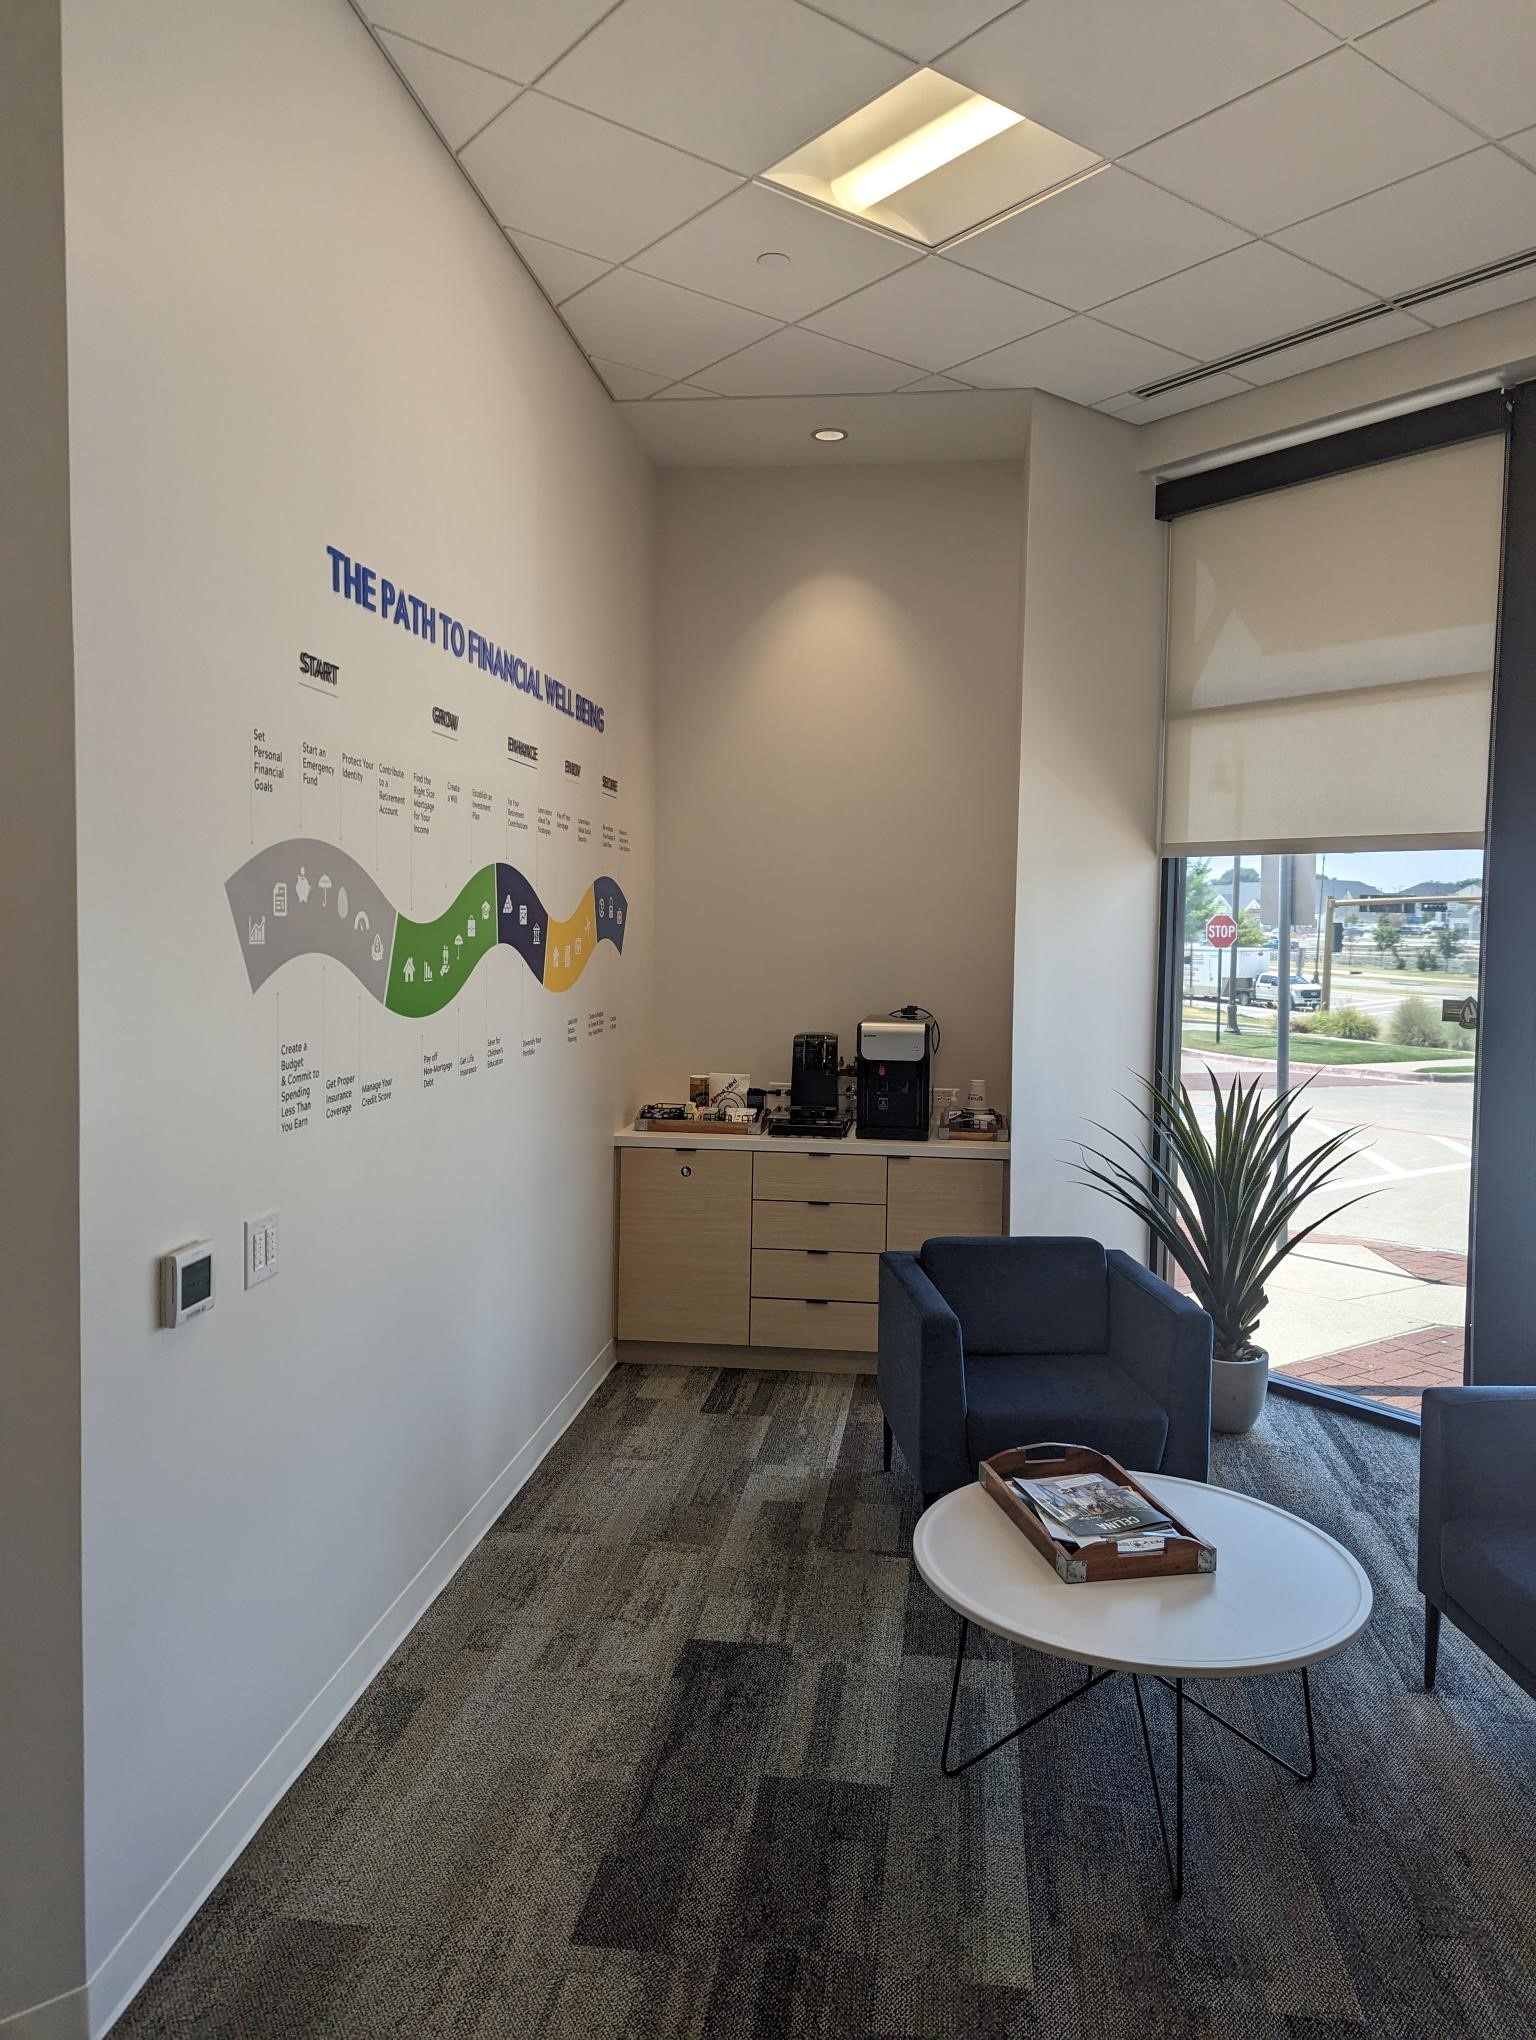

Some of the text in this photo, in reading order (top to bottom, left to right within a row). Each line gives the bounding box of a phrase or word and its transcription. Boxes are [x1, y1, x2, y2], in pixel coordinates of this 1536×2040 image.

[327, 545, 604, 732] THE PATH TO FINANCIAL WELL BEING
[300, 652, 339, 685] START
[432, 706, 459, 731] GROW
[253, 729, 265, 742] Set
[254, 745, 282, 762] Personal
[303, 742, 326, 758] Start an
[508, 737, 538, 760] ENHANCE
[303, 758, 334, 776] Emergency
[342, 753, 373, 770] Protect Your
[254, 762, 284, 778] Financial
[343, 767, 363, 783] Identity
[379, 763, 404, 778] Contribute
[254, 779, 273, 792] Goals
[303, 773, 318, 786] Fund
[379, 778, 384, 787] to
[379, 791, 405, 805] Retirement
[379, 805, 398, 816] Account
[1209, 925, 1235, 938] STOP
[281, 1043, 307, 1055] Create a
[281, 1058, 304, 1071] Budget
[281, 1070, 320, 1086] & Commit to
[326, 1075, 355, 1090] Get Proper
[362, 1078, 393, 1093] Manage Your
[281, 1087, 310, 1103] Spending
[326, 1090, 352, 1104] Insurance
[362, 1091, 392, 1107] Credit Score
[281, 1101, 311, 1118] Less Than
[326, 1104, 352, 1118] Coverage
[281, 1118, 308, 1133] You Earn
[1096, 1516, 1140, 1530] CELINA
